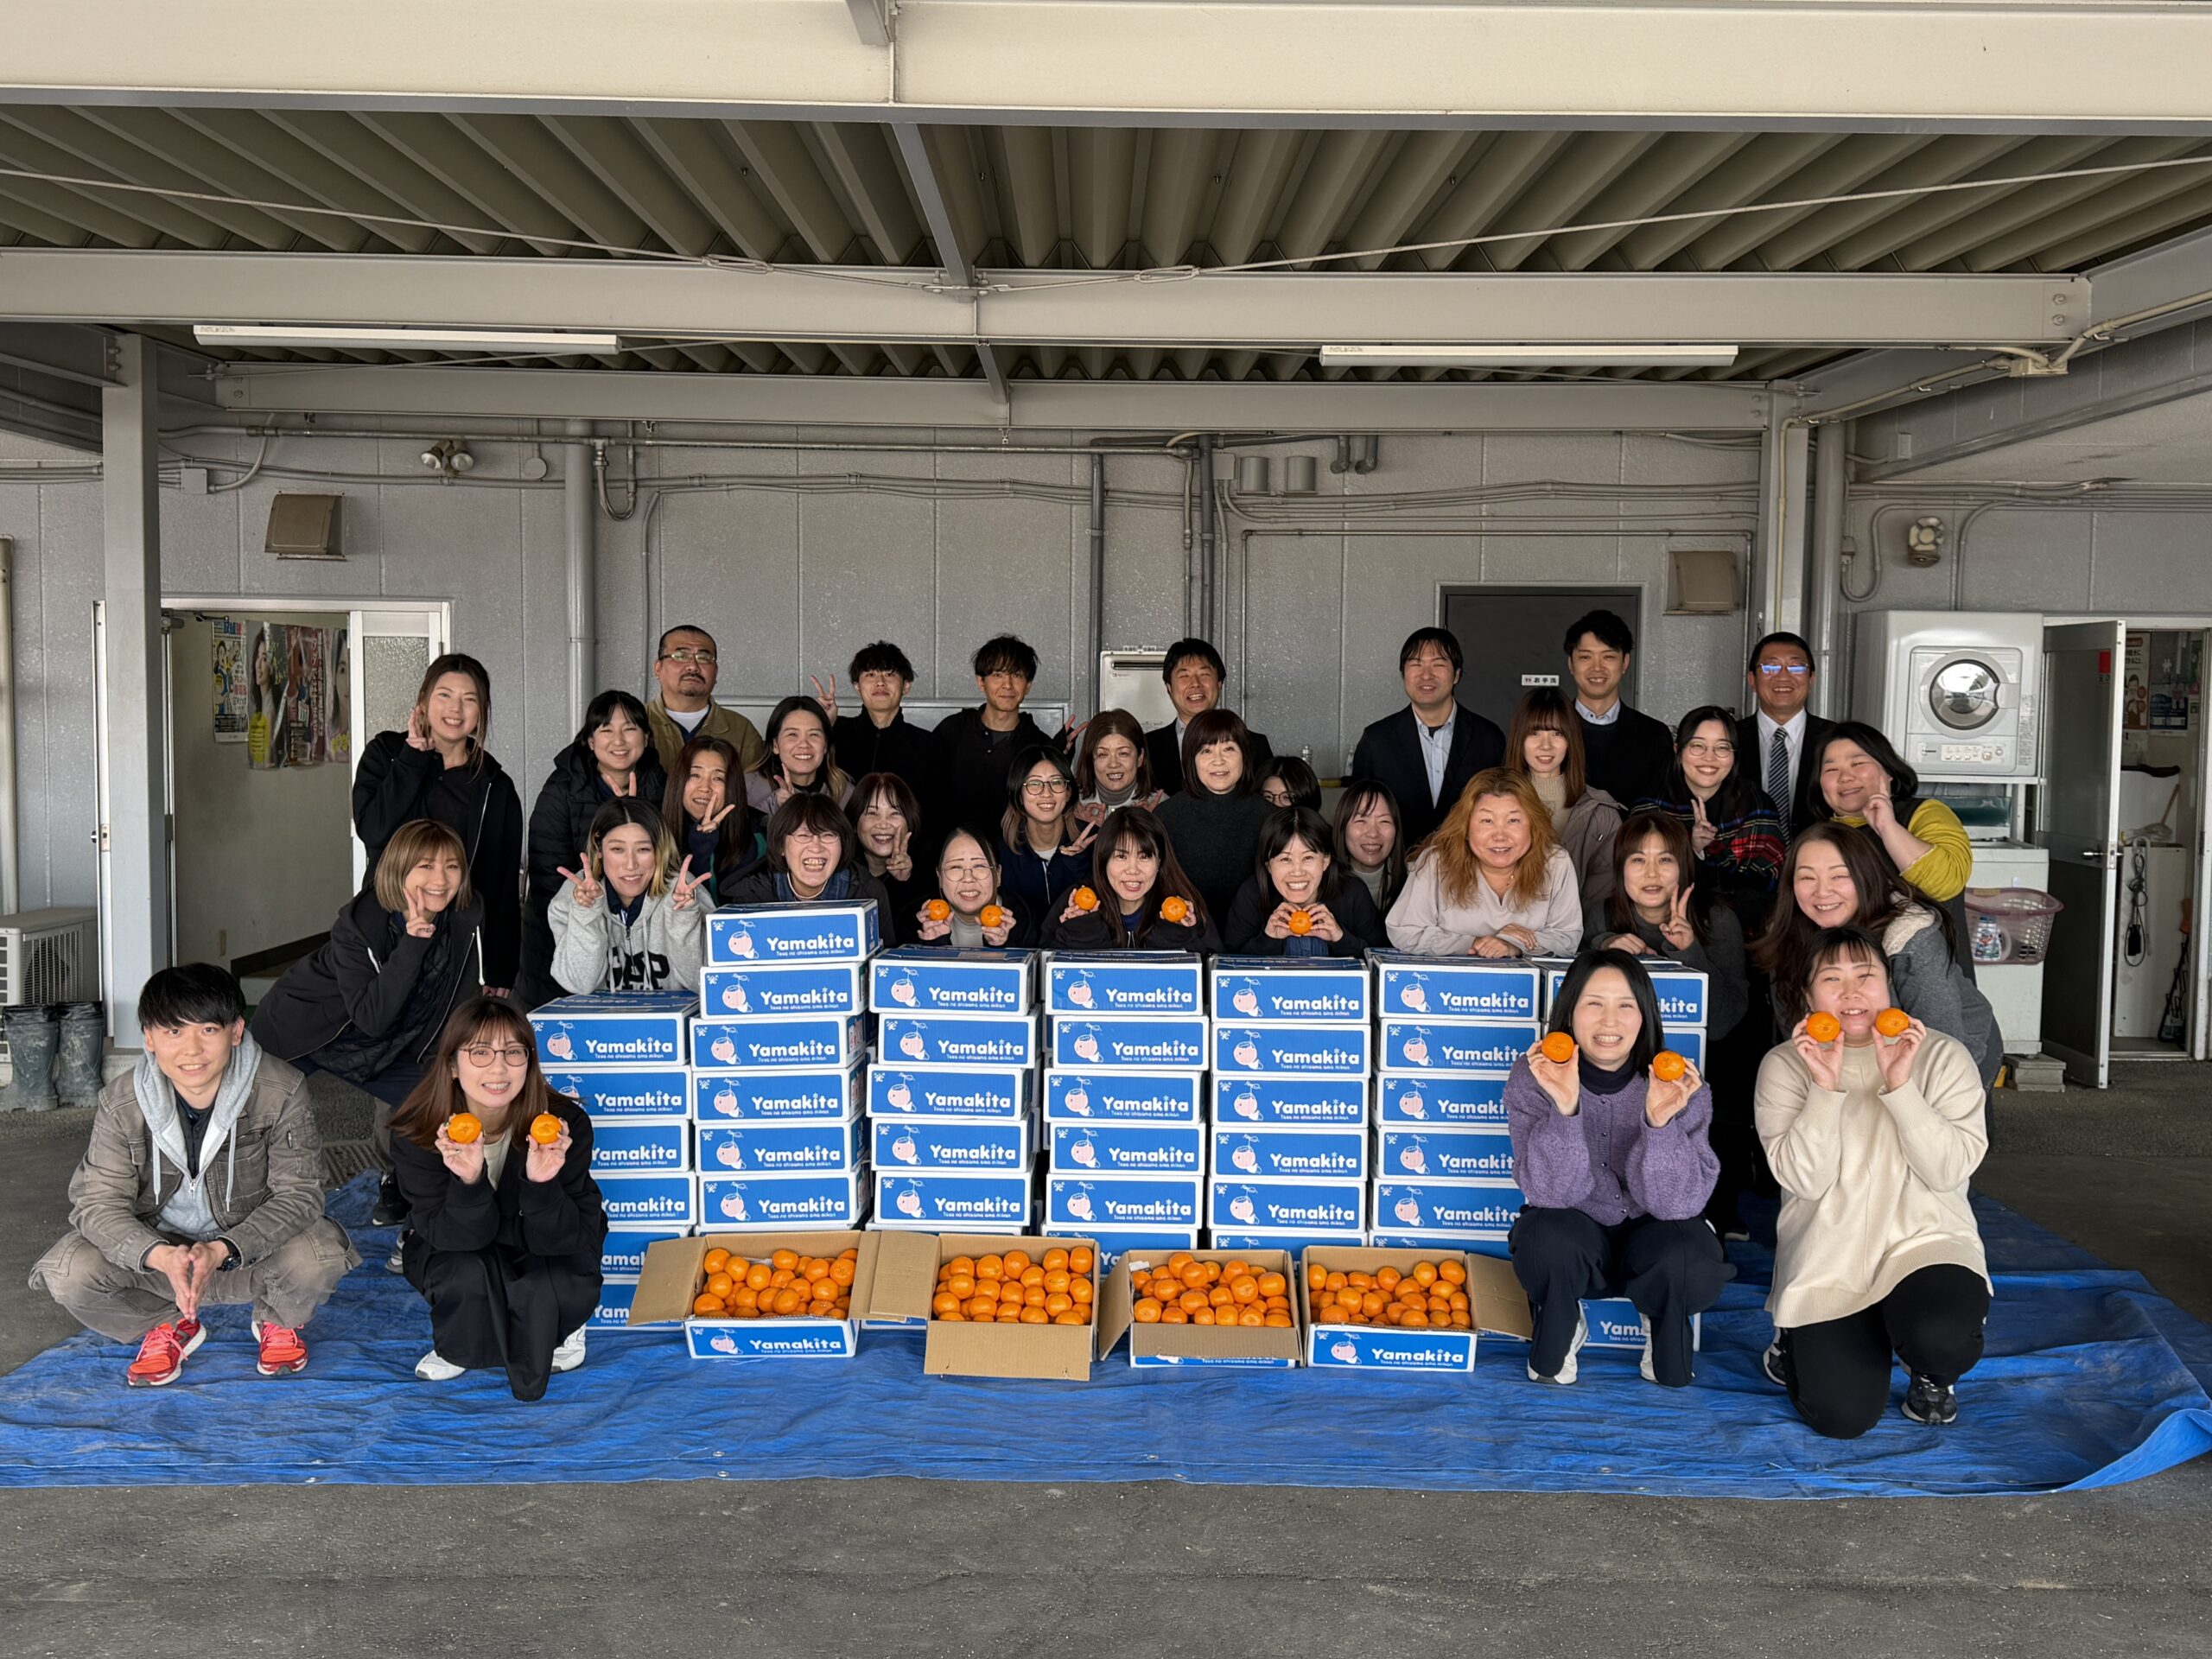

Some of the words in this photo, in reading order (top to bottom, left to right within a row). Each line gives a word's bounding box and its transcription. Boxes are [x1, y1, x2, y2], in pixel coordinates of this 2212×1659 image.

[766, 932, 855, 951] Yamakita
[760, 987, 848, 1005] Yamakita
[929, 986, 1015, 1003] Yamakita
[1106, 987, 1192, 1002] Yamakita
[1271, 994, 1359, 1010] Yamakita
[1440, 991, 1529, 1008] Yamakita
[1660, 996, 1698, 1014] kita
[586, 1037, 673, 1053] Yamakita
[749, 1039, 836, 1058] Yamakita
[938, 1039, 1024, 1055] Yamakita
[1112, 1039, 1198, 1056] Yamakita
[1441, 1045, 1526, 1061] Yamakit
[1272, 1048, 1359, 1065] Yamakita
[594, 1090, 682, 1107] Yamakita
[752, 1093, 838, 1110] Yamakita
[925, 1091, 1011, 1108] Yamakita
[1103, 1095, 1189, 1112] Yamakita
[1272, 1098, 1358, 1115] Yamakita
[1438, 1099, 1509, 1114] Yamaki
[592, 1143, 677, 1160] Yamakita
[754, 1145, 841, 1162] Yamakita
[930, 1143, 1016, 1160] Yamakita
[1109, 1146, 1195, 1162] Yamakita
[1270, 1152, 1357, 1168] Yamakita
[1438, 1153, 1514, 1169] Yamakit
[759, 1196, 845, 1213] Yamakita
[935, 1196, 1020, 1212] Yamakita
[1105, 1199, 1192, 1216] Yamakita
[1268, 1204, 1355, 1220] Yamakita
[749, 1338, 841, 1350] Yamakita
[1371, 1348, 1464, 1363] Yamakita
